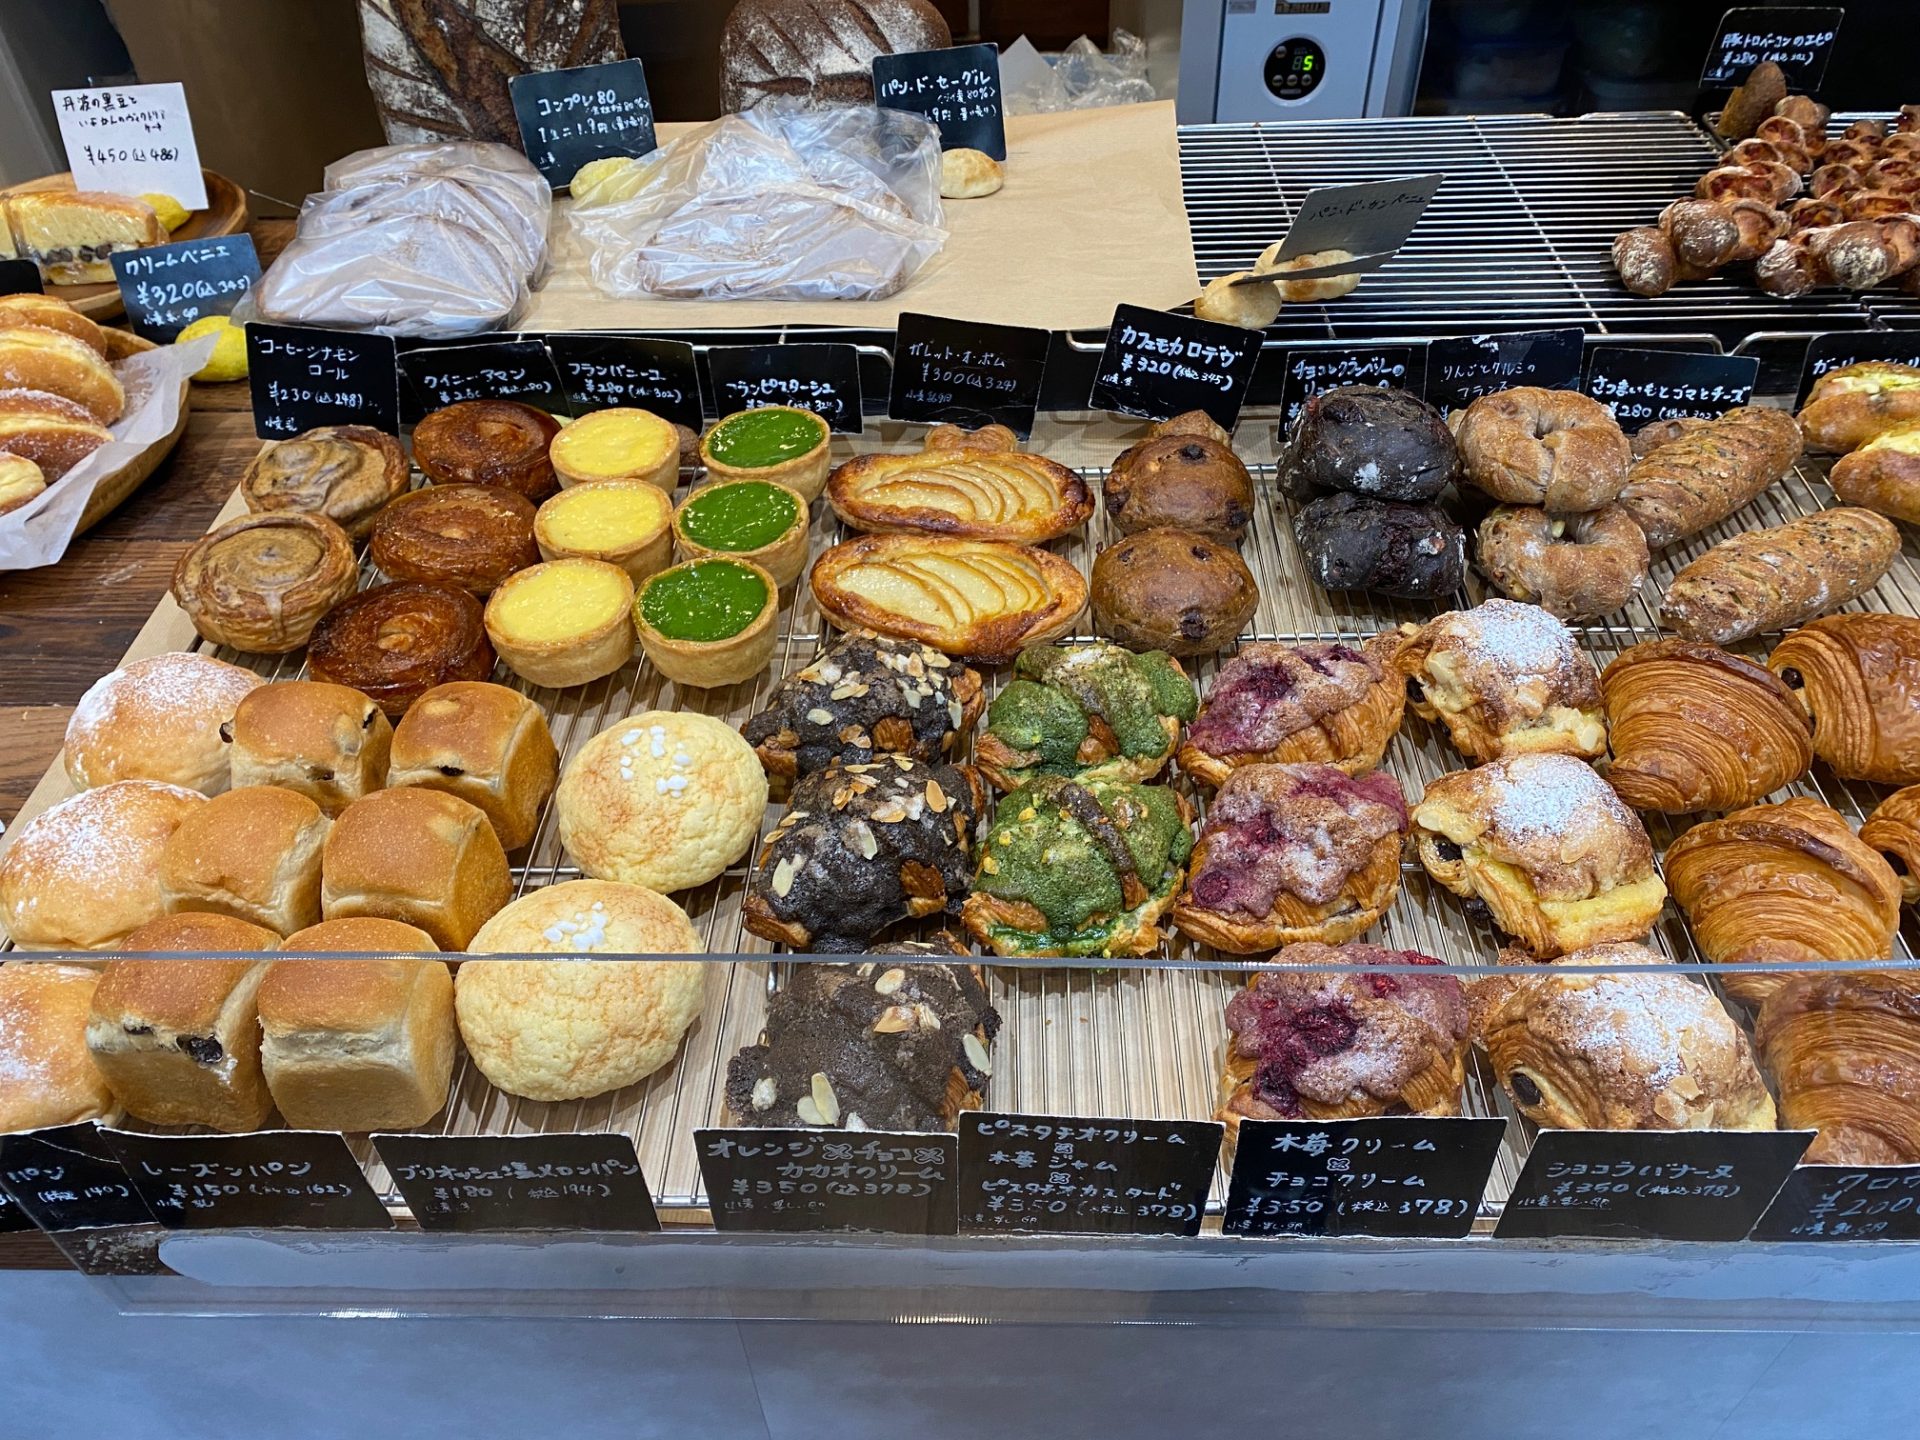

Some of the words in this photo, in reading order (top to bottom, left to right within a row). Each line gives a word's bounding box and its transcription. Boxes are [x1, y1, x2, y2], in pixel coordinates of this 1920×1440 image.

[63, 92, 137, 112] 丹波の黒豆と
[308, 364, 350, 380] ロール
[1443, 362, 1536, 381] りんごとクルミの
[1592, 375, 1752, 403] さつまいもとゴマとチーズ
[977, 1119, 1186, 1145] ピスタチオクリーム
[776, 1162, 945, 1180] カカオクリーム
[1546, 1161, 1735, 1179] ショコラバナーヌ
[981, 1178, 1182, 1198] ピスタチオカスタード
[1266, 1171, 1425, 1189] チョコクリーム
